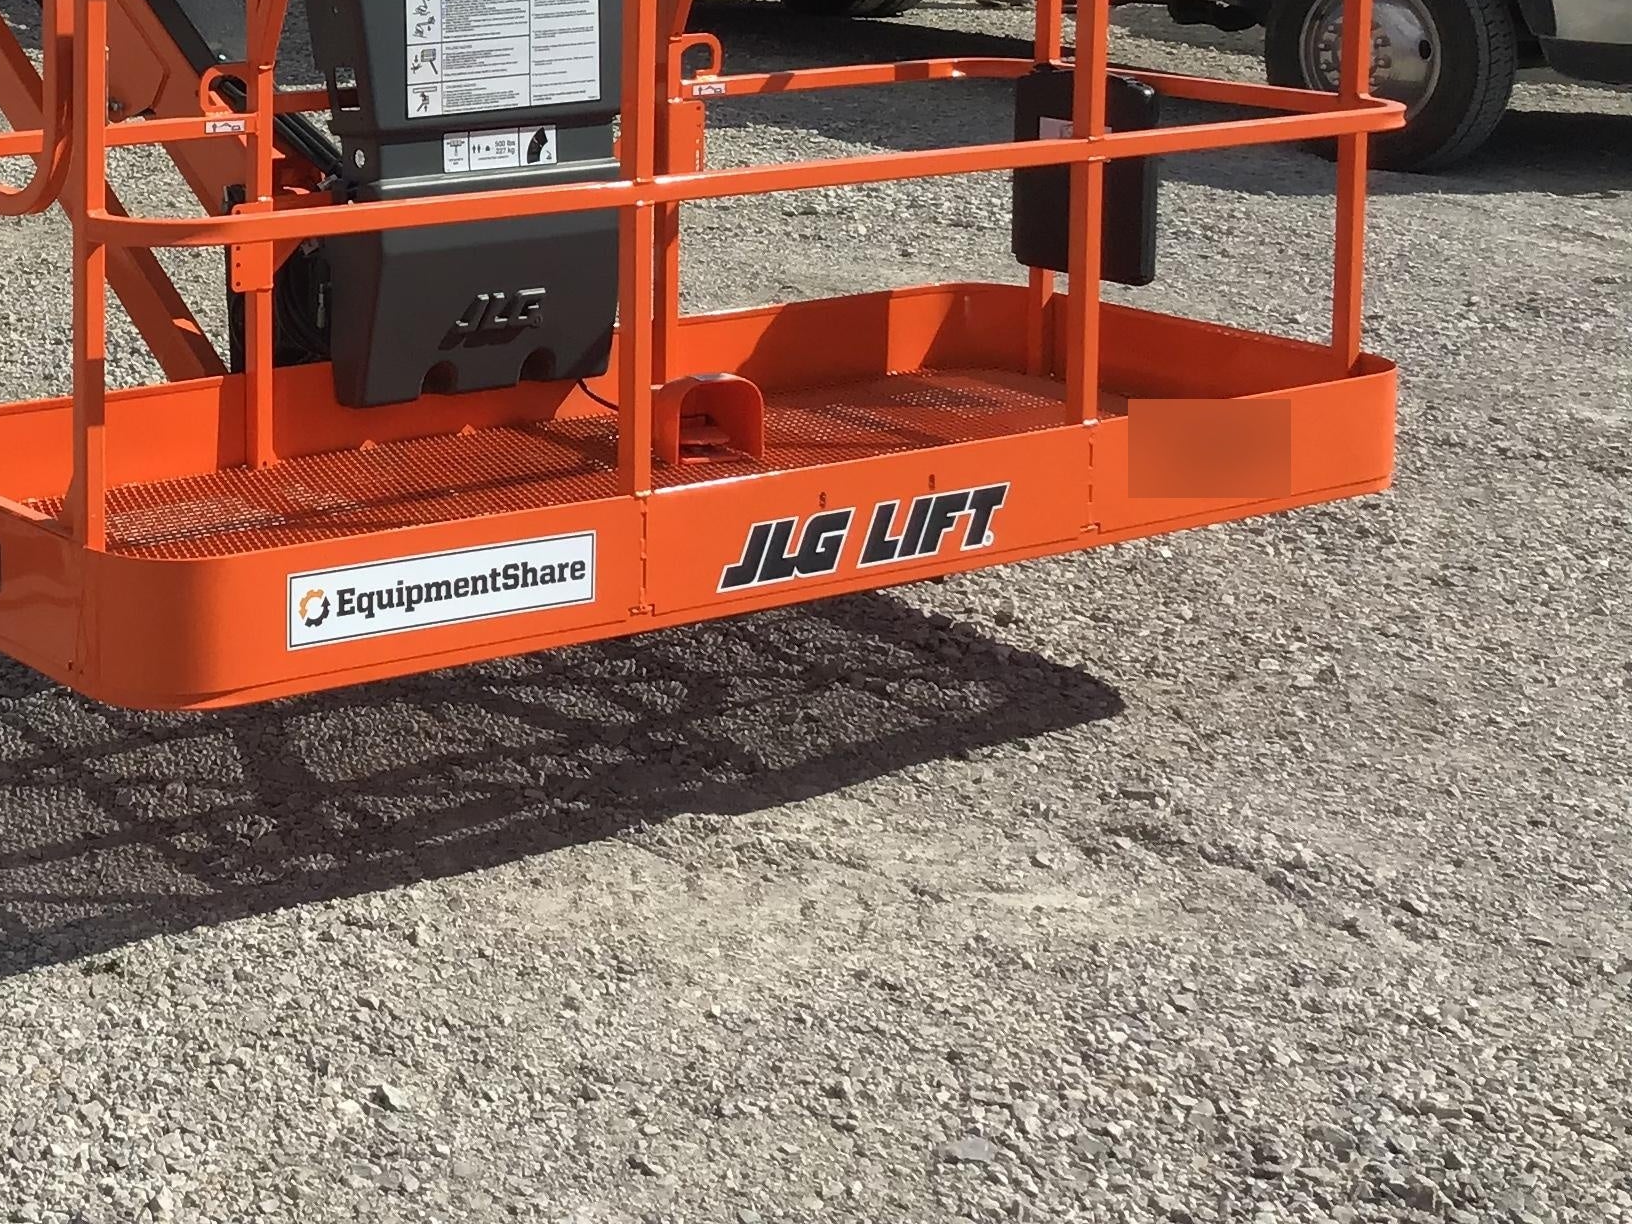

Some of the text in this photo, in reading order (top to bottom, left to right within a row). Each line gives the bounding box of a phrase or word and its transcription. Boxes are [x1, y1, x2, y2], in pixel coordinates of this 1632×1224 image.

[717, 482, 1011, 593] JLG LIFT
[336, 559, 587, 619] EquipmentShare
